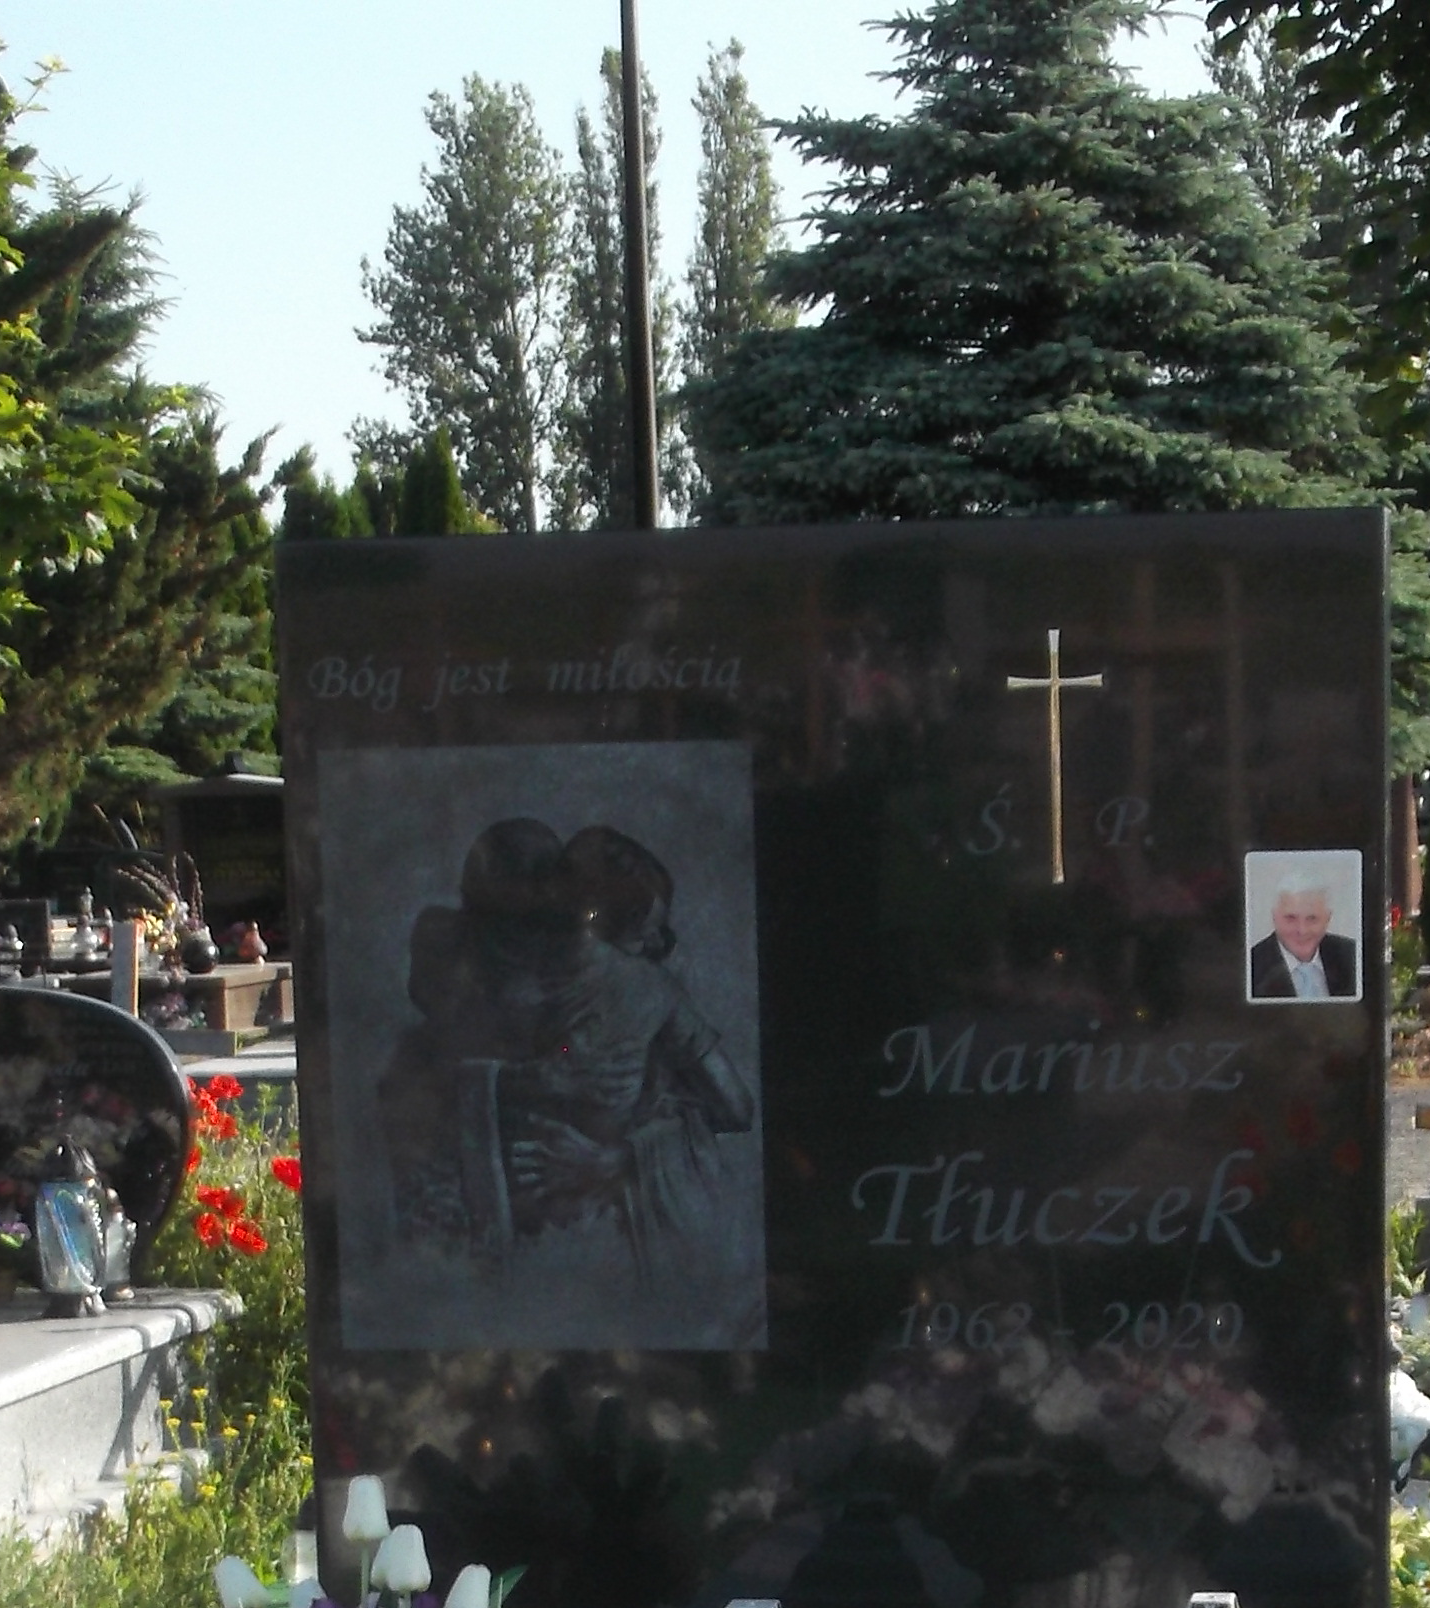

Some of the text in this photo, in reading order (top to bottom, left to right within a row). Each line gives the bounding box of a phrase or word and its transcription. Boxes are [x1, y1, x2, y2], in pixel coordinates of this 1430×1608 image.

[308, 643, 743, 713] Bóg jest miłością
[1096, 796, 1155, 848] P.
[878, 1020, 1253, 1097] Mariusz
[851, 1149, 1282, 1270] Tłuczek
[1096, 1302, 1244, 1350] 2020
